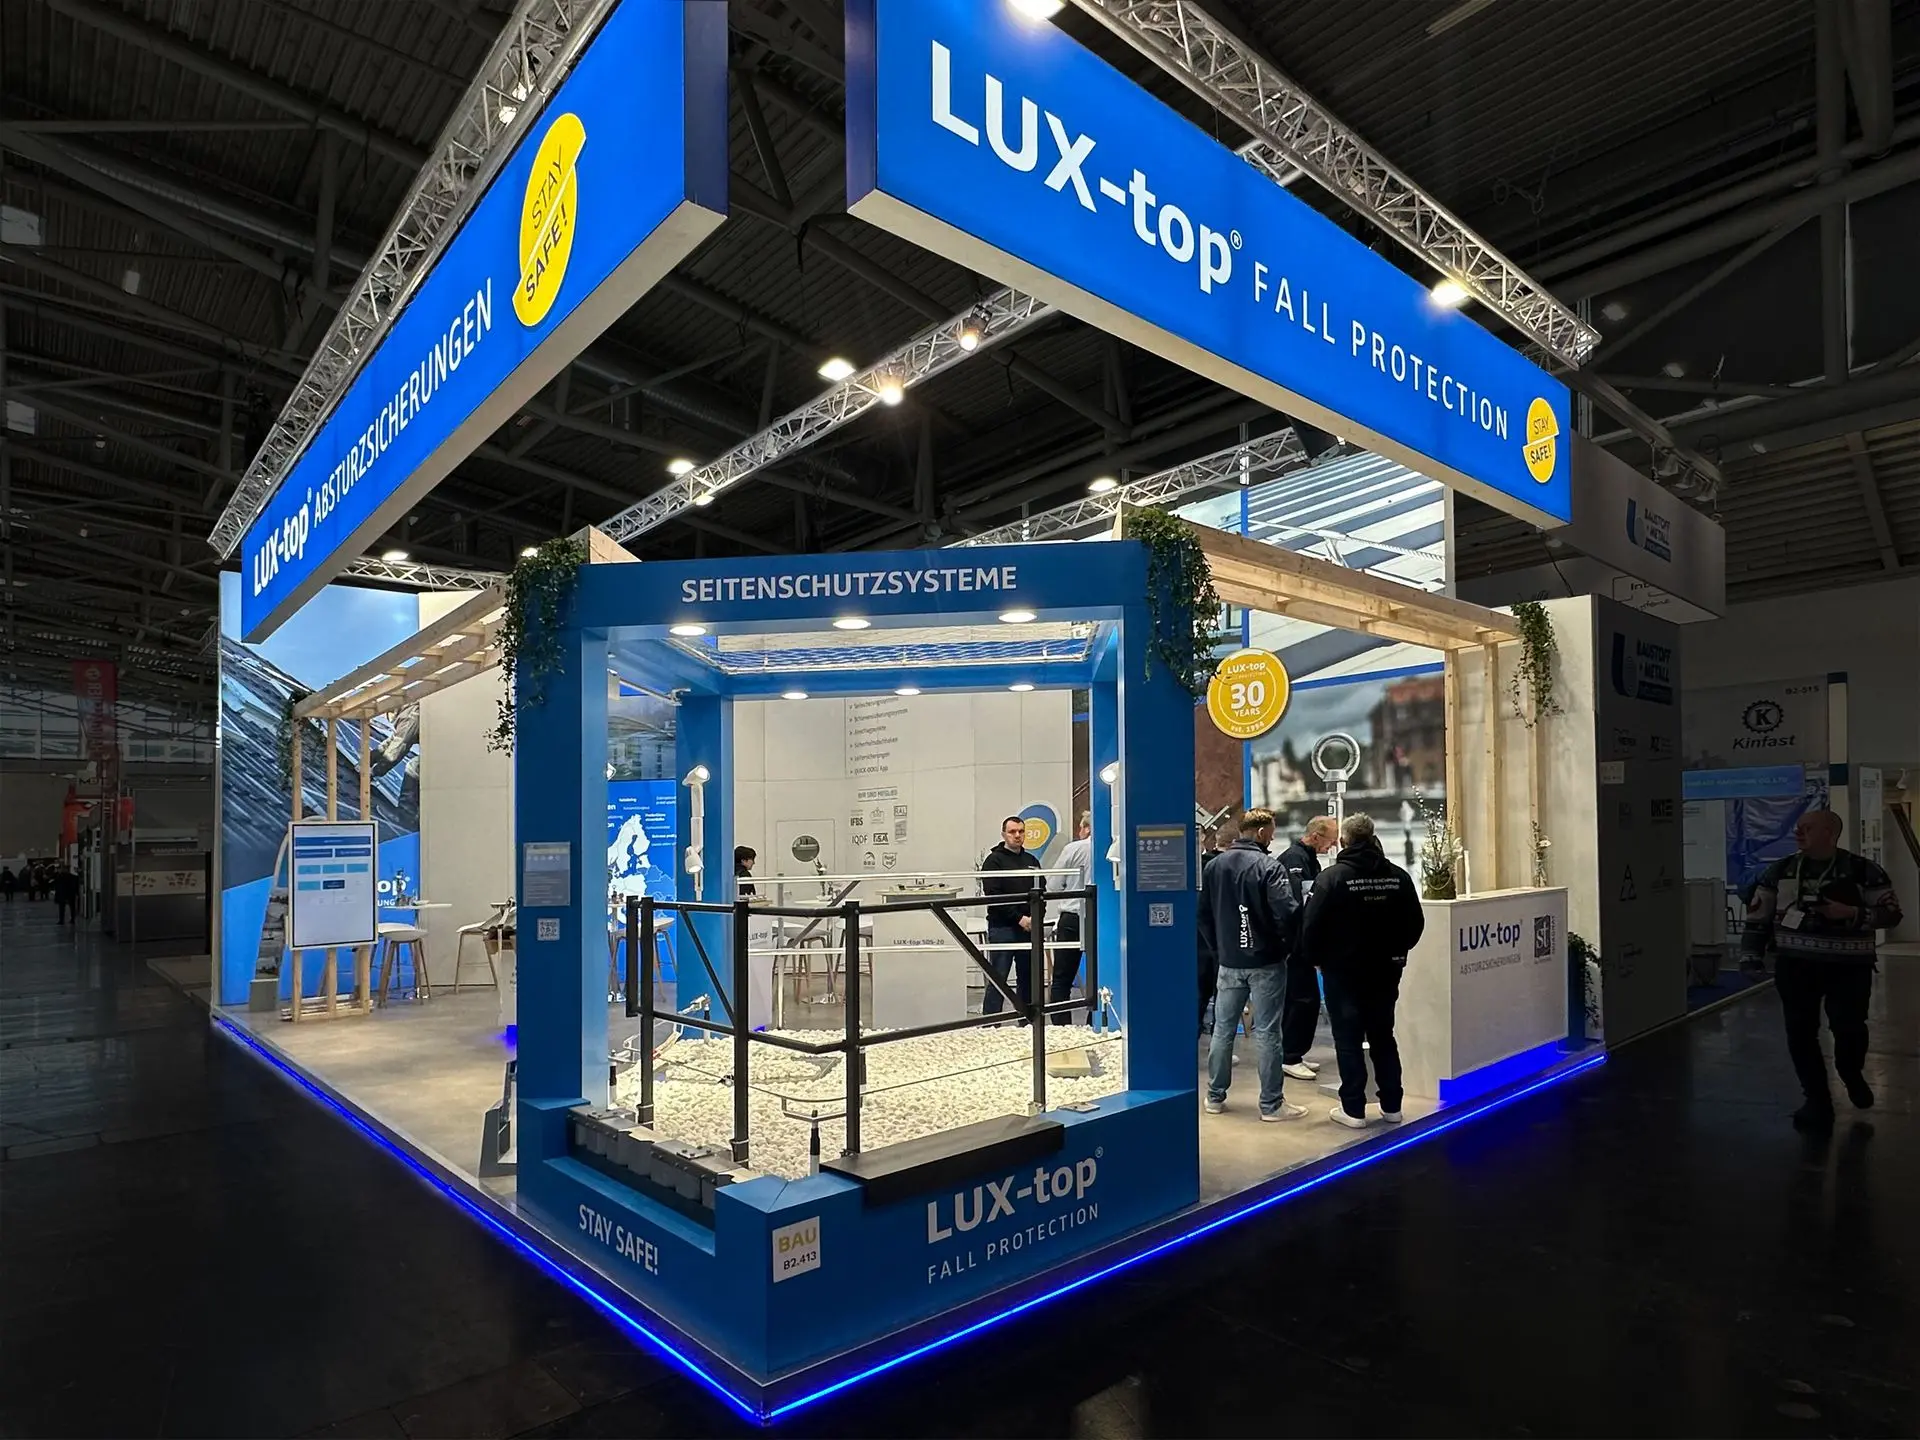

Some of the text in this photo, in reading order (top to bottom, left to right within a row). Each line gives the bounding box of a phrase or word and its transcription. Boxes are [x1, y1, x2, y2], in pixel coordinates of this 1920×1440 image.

[532, 145, 562, 229] STAY
[526, 203, 568, 301] SAFE!
[1254, 262, 1336, 345] FALL
[1352, 320, 1509, 441] PROTECTION
[314, 278, 492, 528] ABSTURZSICHERUNGEN
[1533, 414, 1551, 436] STAY
[1530, 446, 1553, 465] SAFE!
[682, 566, 1018, 603] SEITENSCHUTZSYSTEME
[1227, 662, 1266, 674] LUX-top
[1231, 680, 1265, 710] 30
[1234, 707, 1261, 717] YEARS
[1732, 735, 1796, 750] Kinfast
[1027, 830, 1041, 839] 30
[579, 1203, 659, 1276] STAY SAFE!
[778, 1226, 818, 1253] BAU
[928, 1203, 1099, 1284] FALL PROTECTION
[783, 1250, 818, 1272] B2.413
